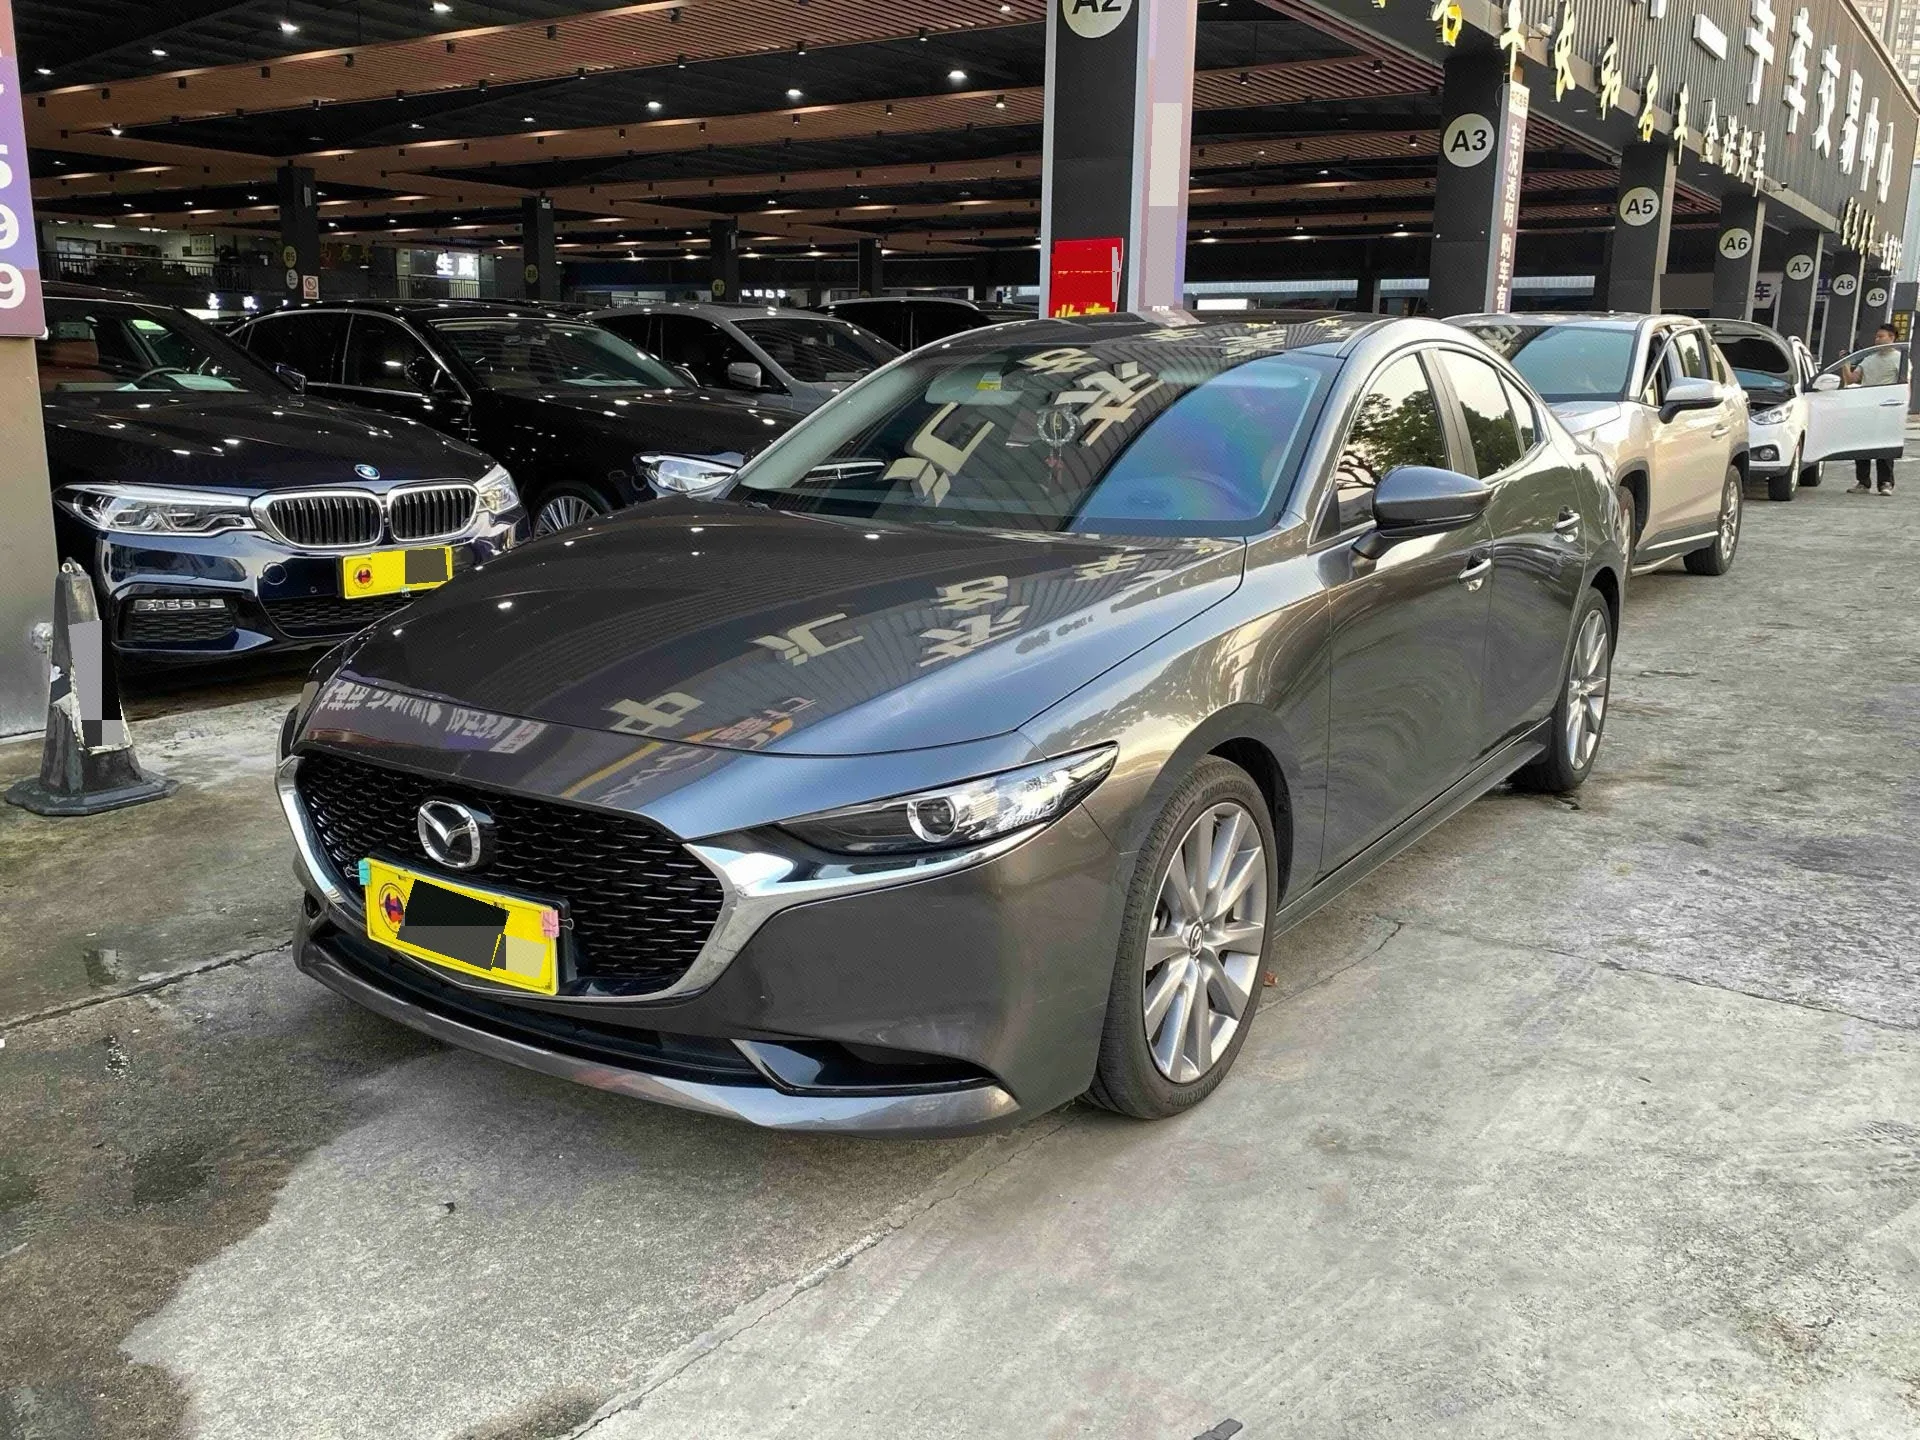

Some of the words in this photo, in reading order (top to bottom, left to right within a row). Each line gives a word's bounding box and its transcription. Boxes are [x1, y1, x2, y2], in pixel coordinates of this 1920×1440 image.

[1449, 128, 1488, 154] A3
[1625, 198, 1655, 216] A5
[1723, 237, 1748, 251] A6
[1790, 262, 1812, 273] A7
[1835, 280, 1854, 290] A8
[1868, 292, 1885, 302] A9
